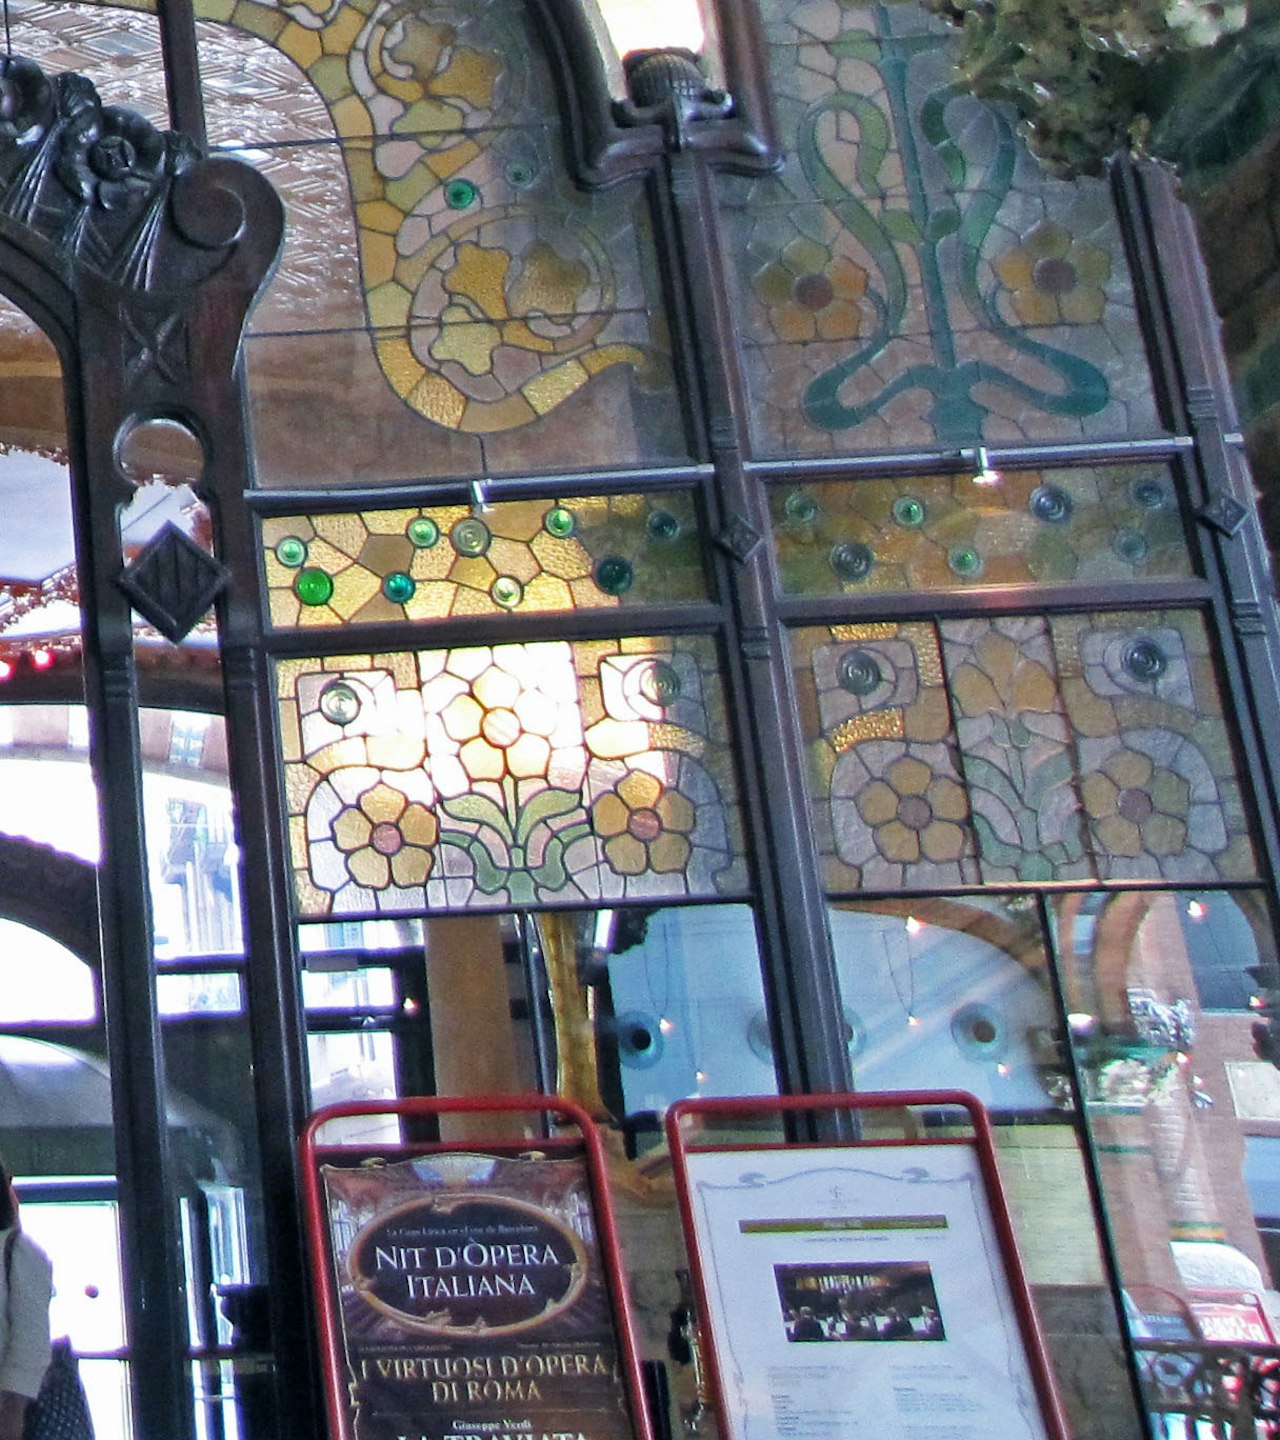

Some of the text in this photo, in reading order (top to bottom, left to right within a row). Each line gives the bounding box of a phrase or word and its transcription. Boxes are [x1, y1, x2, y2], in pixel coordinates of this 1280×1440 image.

[375, 1237, 559, 1270] NIT D'ÒPERA
[407, 1274, 536, 1298] ITALIANA
[376, 1356, 493, 1379] VIRTUOSI
[501, 1354, 608, 1377] D'OPERA
[432, 1380, 542, 1403] DI ROMA
[452, 1418, 532, 1431] Giuseppe Verdi
